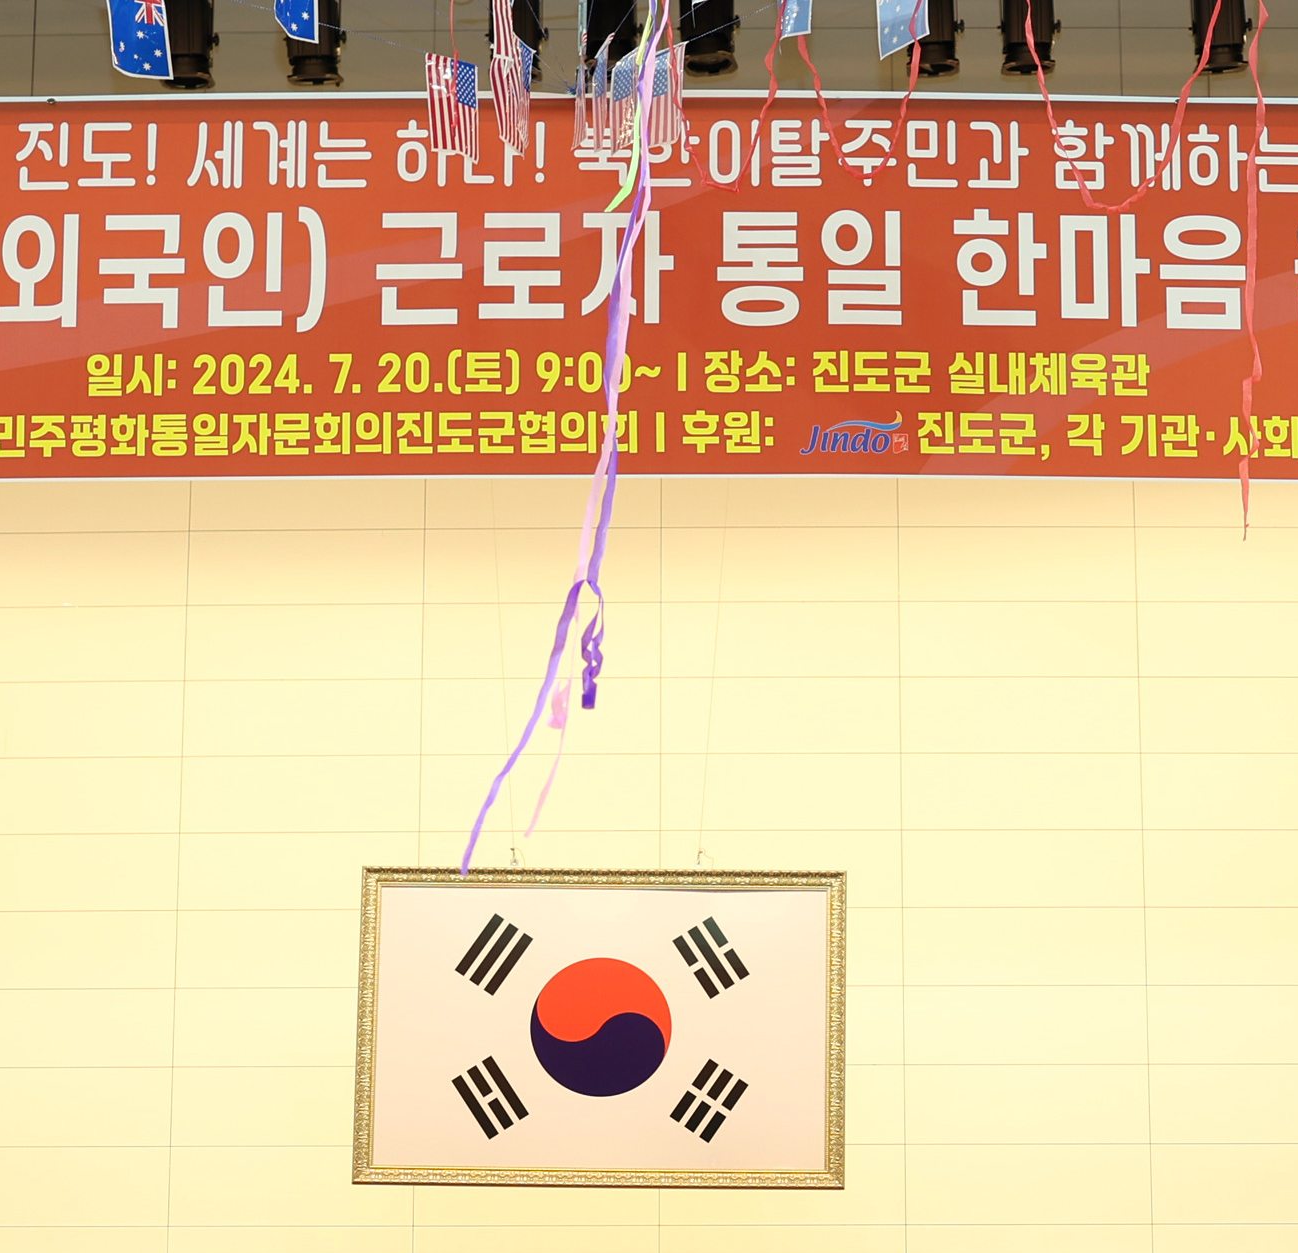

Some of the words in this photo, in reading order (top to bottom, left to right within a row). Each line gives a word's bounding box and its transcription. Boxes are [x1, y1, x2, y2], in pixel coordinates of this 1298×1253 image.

[14, 121, 159, 192] 진도!
[187, 120, 370, 190] 세계는
[374, 209, 674, 331] 근로자
[715, 208, 904, 329] 통일
[953, 207, 1249, 331] 한마음
[86, 352, 177, 397] 일시:
[192, 351, 301, 396] 2024.
[328, 353, 360, 395] 7.
[377, 350, 521, 396] 20.(토)
[536, 352, 662, 396] 9:00~
[704, 352, 798, 393] 장소:
[811, 351, 932, 395] 진도군
[948, 351, 1151, 398] 실내체육관
[682, 412, 775, 453] 후원:
[799, 425, 891, 456] Jindo
[917, 411, 1050, 458] 진도군,
[1067, 412, 1105, 456] 각
